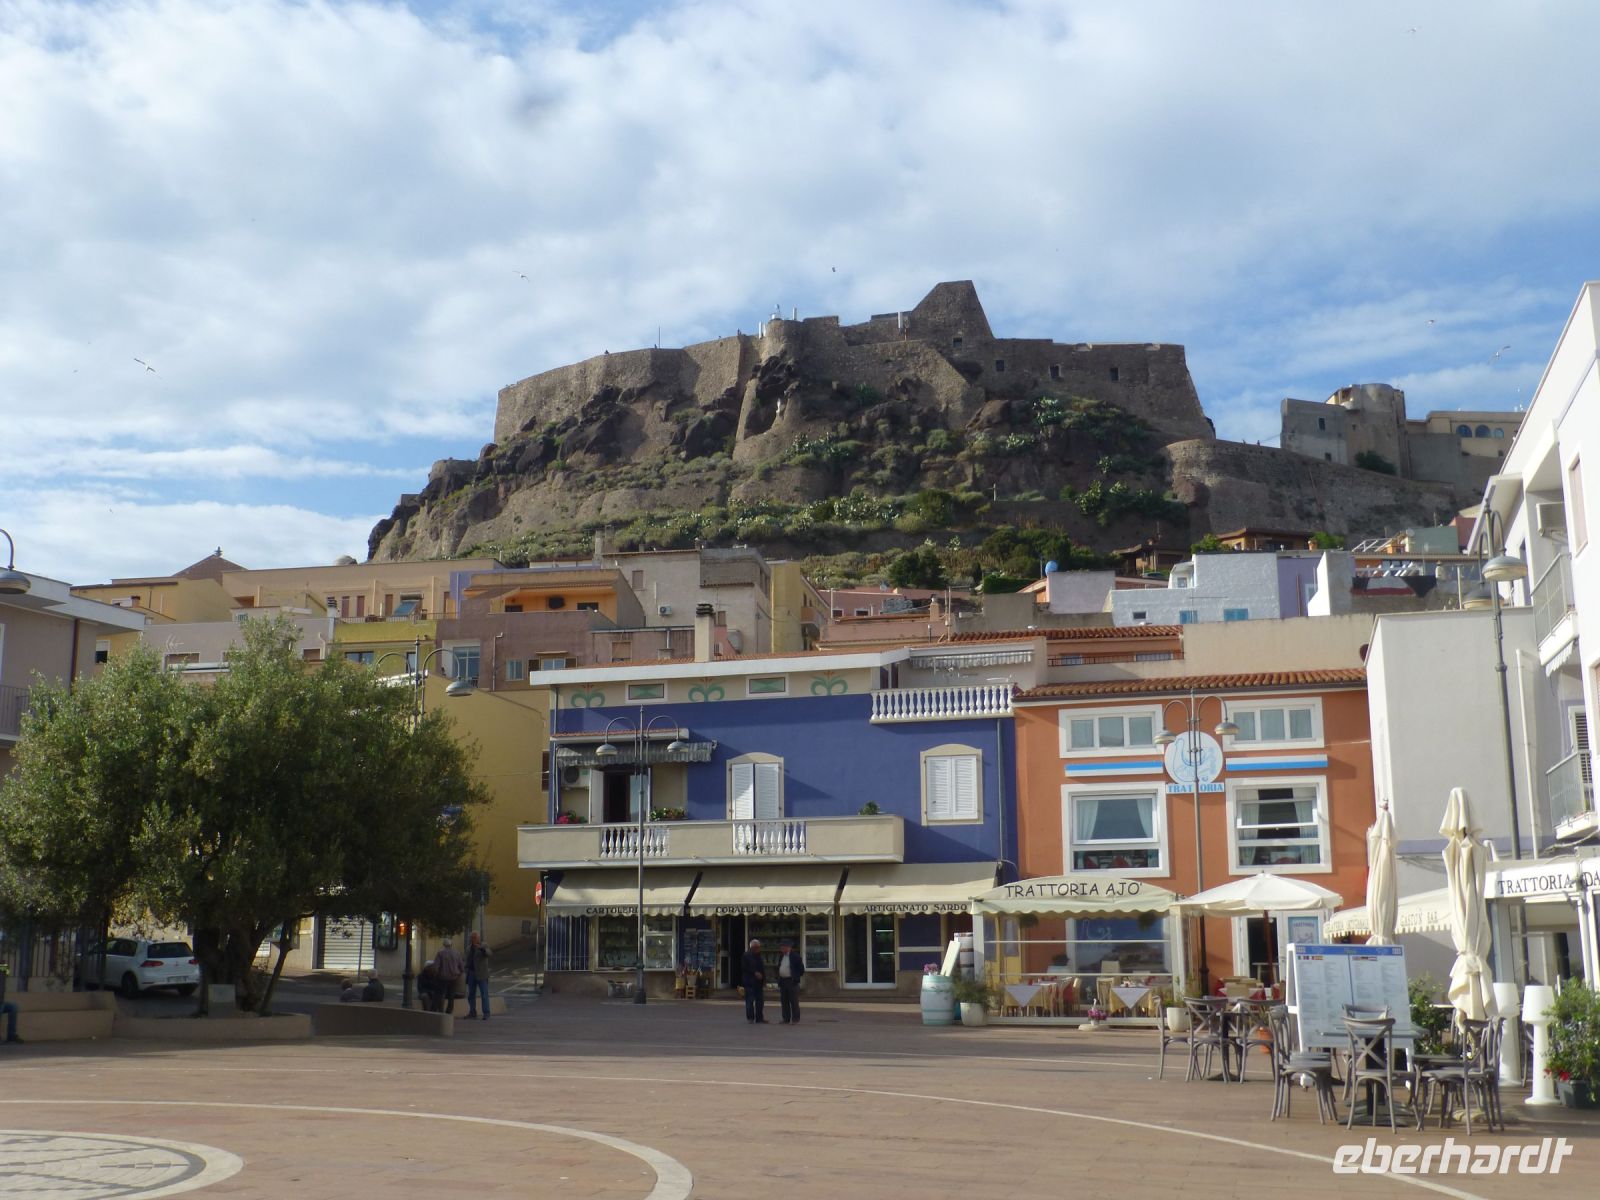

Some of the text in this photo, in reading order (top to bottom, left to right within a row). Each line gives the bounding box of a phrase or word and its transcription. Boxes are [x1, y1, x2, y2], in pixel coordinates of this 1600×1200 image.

[1168, 783, 1223, 793] TRATORIA
[1498, 873, 1574, 895] TRATTORIA
[1004, 882, 1099, 898] TRATTORIA
[586, 905, 639, 915] CARTOLERI
[715, 904, 808, 914] CORALLI FILIGRANA
[864, 903, 968, 912] ARTIGIANATO SARDO
